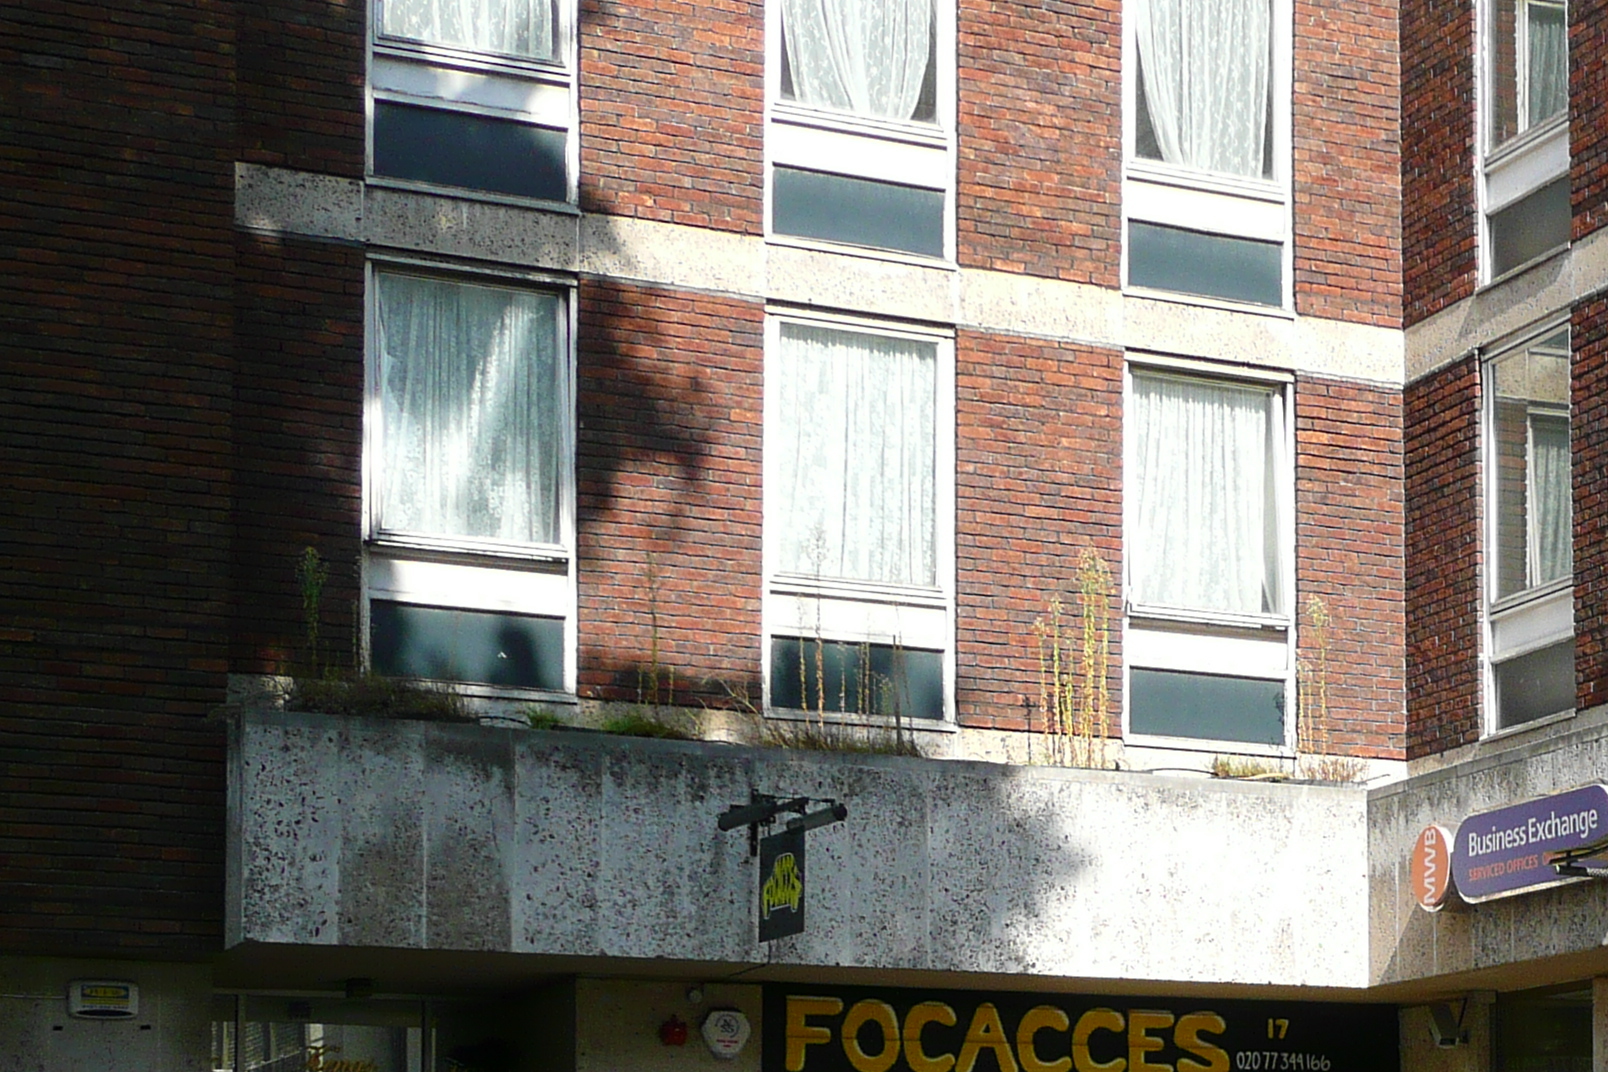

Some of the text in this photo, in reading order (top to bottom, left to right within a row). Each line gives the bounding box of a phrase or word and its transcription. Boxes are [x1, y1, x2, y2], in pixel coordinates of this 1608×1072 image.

[1468, 809, 1598, 857] Business Exchange
[1423, 828, 1437, 904] MWB
[1469, 861, 1505, 881] SERVICED
[1506, 854, 1539, 873] OFFICES
[1267, 1017, 1290, 1040] 17
